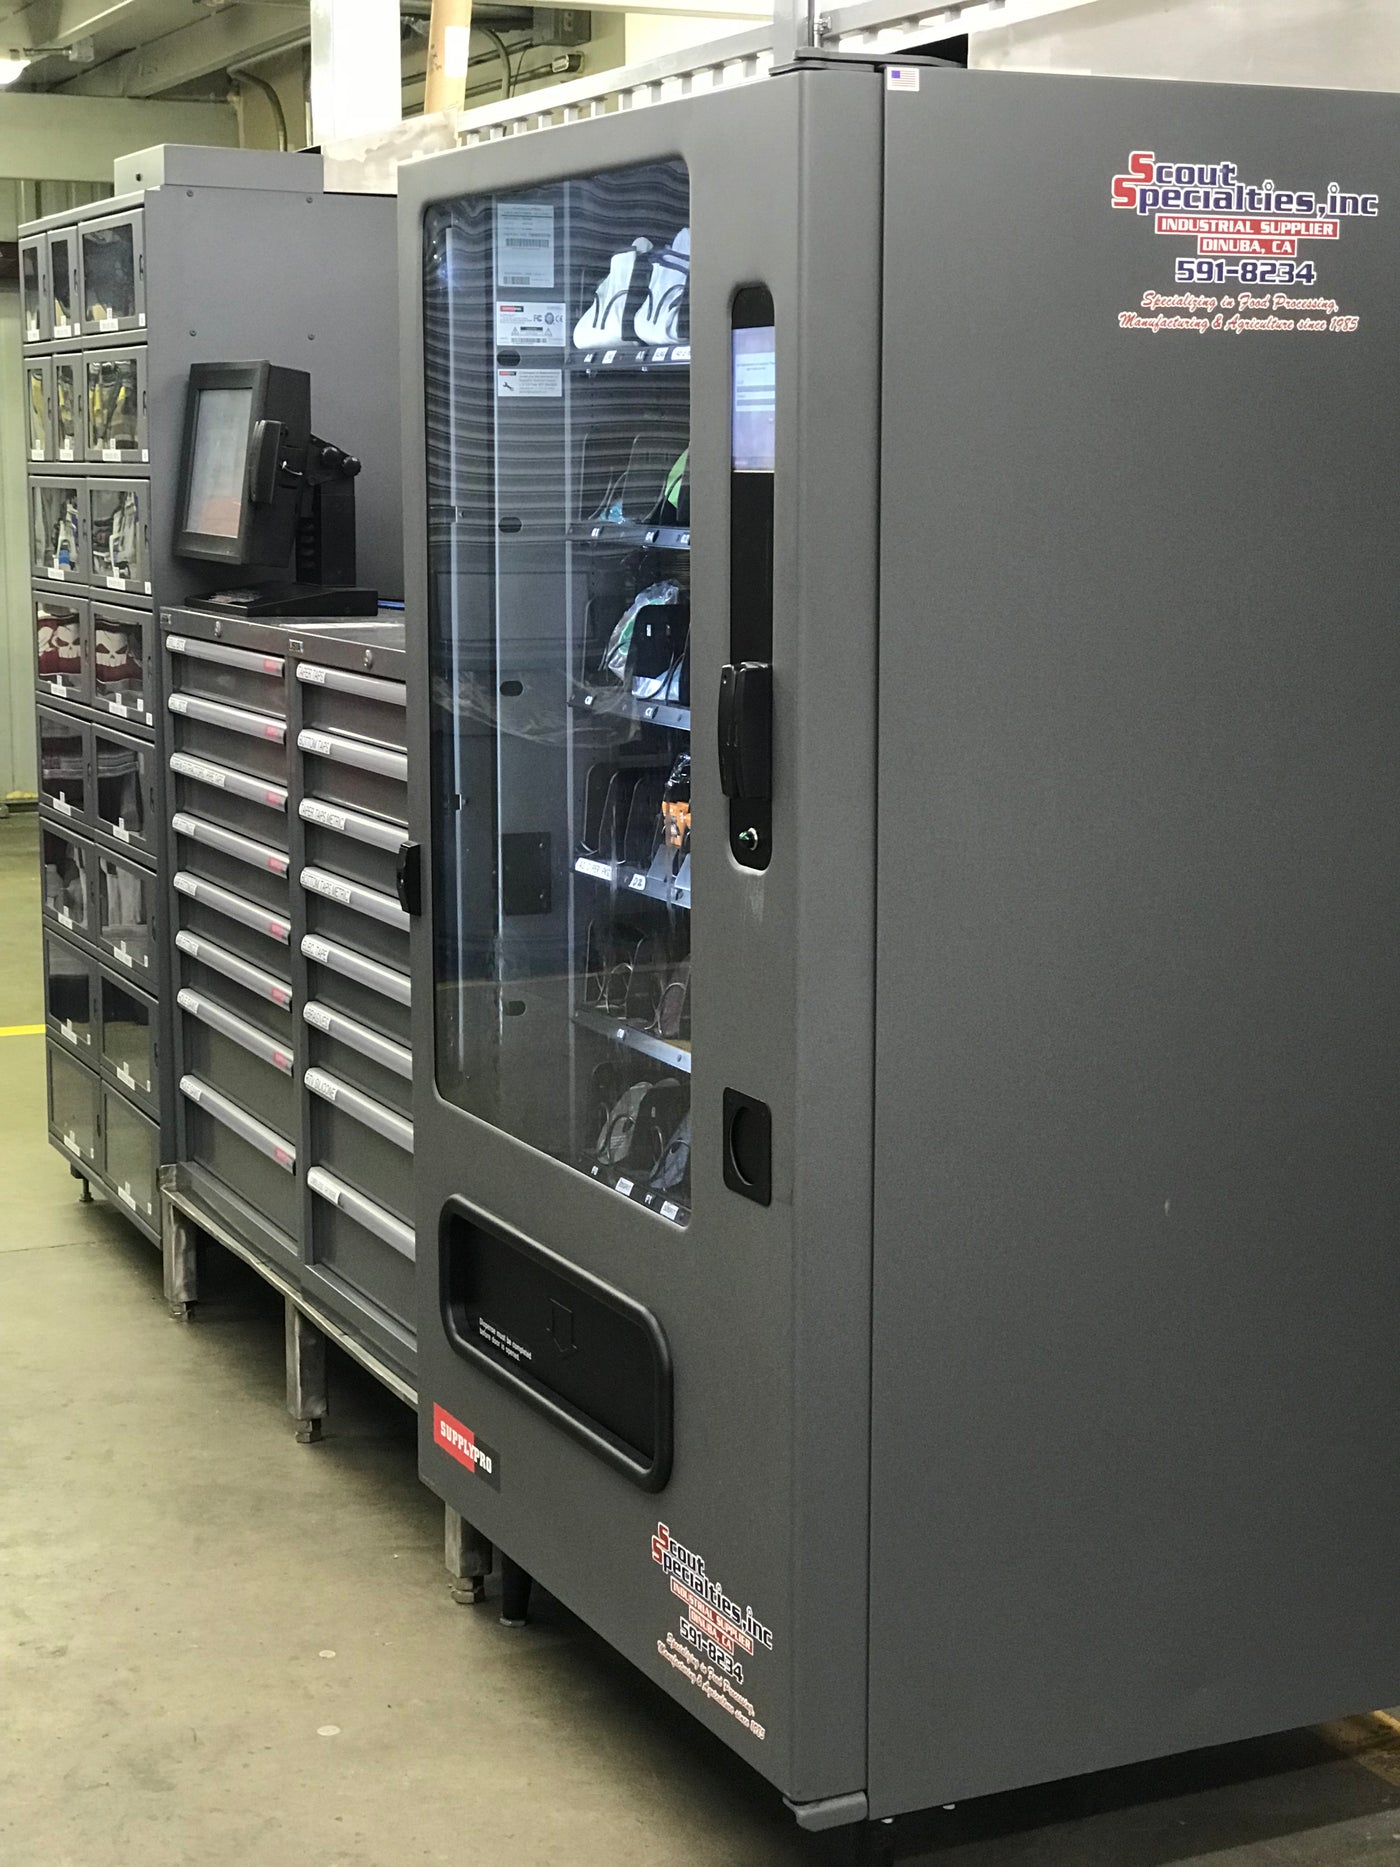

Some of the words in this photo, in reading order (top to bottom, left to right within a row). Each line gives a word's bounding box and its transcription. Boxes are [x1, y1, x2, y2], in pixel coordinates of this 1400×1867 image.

[1128, 151, 1237, 188] Scout
[1111, 175, 1378, 217] Specialties,inc
[1162, 217, 1254, 234] INDUSTRIAL
[1260, 220, 1333, 236] SUPPLIER
[1202, 239, 1265, 254] DINUBA,
[1271, 240, 1292, 253] CA
[1176, 258, 1316, 285] 591-8234
[1141, 290, 1217, 312] Specializing
[1220, 293, 1235, 308] in
[1238, 293, 1269, 310] Food
[1118, 312, 1210, 333] Manufacturing
[1212, 315, 1222, 330] &
[1224, 314, 1295, 332] Agriculture
[1297, 317, 1326, 331] since
[1328, 316, 1359, 332] 1985
[440, 1420, 493, 1475] SUPPLYPRO
[658, 1521, 706, 1577] Scout
[673, 1580, 714, 1621] INDUSTRIAL
[716, 1614, 751, 1649] SUPPLIER
[679, 1616, 744, 1685] 591-8234
[721, 1638, 732, 1651] CA
